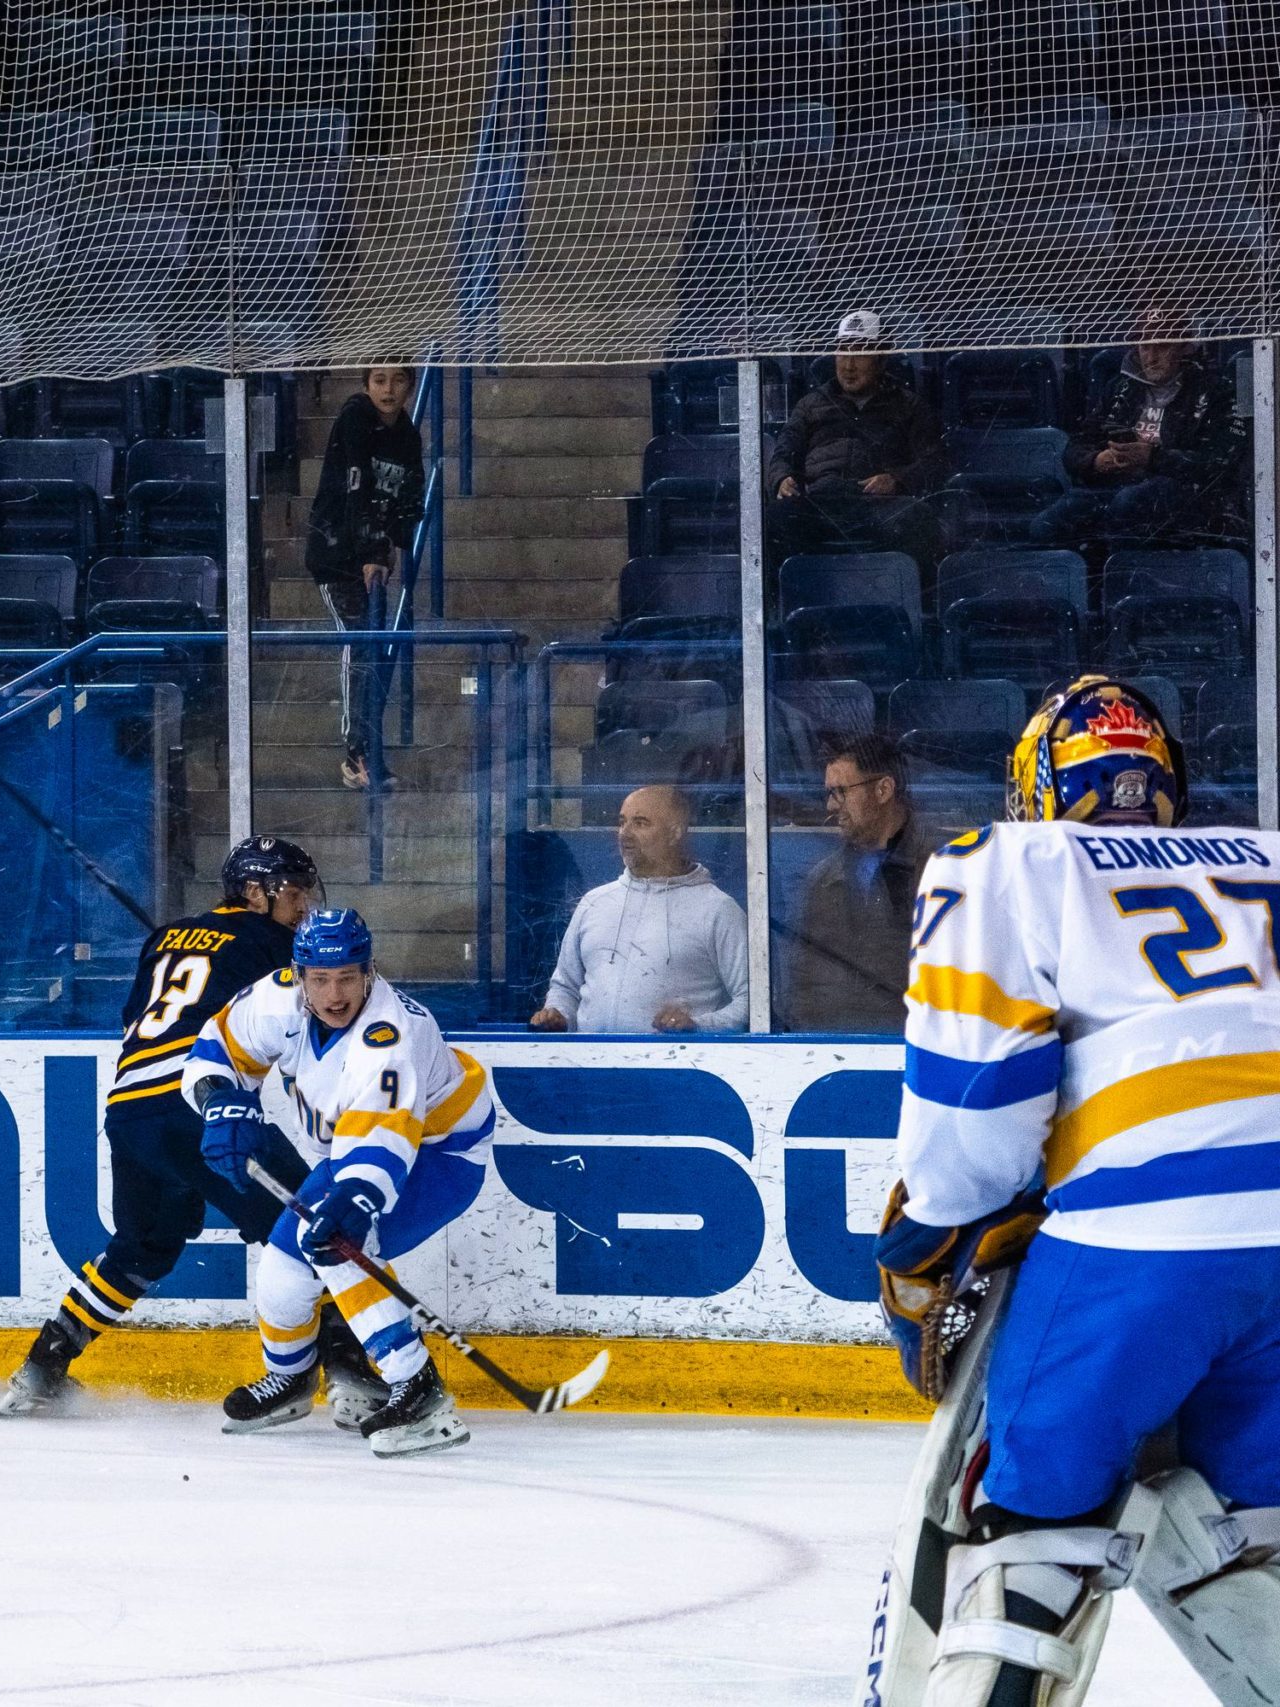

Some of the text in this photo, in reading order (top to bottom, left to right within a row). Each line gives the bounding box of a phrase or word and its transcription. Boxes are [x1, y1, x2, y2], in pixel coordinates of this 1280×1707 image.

[1078, 836, 1271, 870] EDMONDS
[249, 865, 272, 874] CCM
[156, 928, 237, 953] FAUST
[319, 945, 343, 953] CCM
[123, 953, 212, 1040] 13
[380, 1069, 399, 1110] 9
[205, 1105, 264, 1124] CCM
[410, 1303, 475, 1356] CCM
